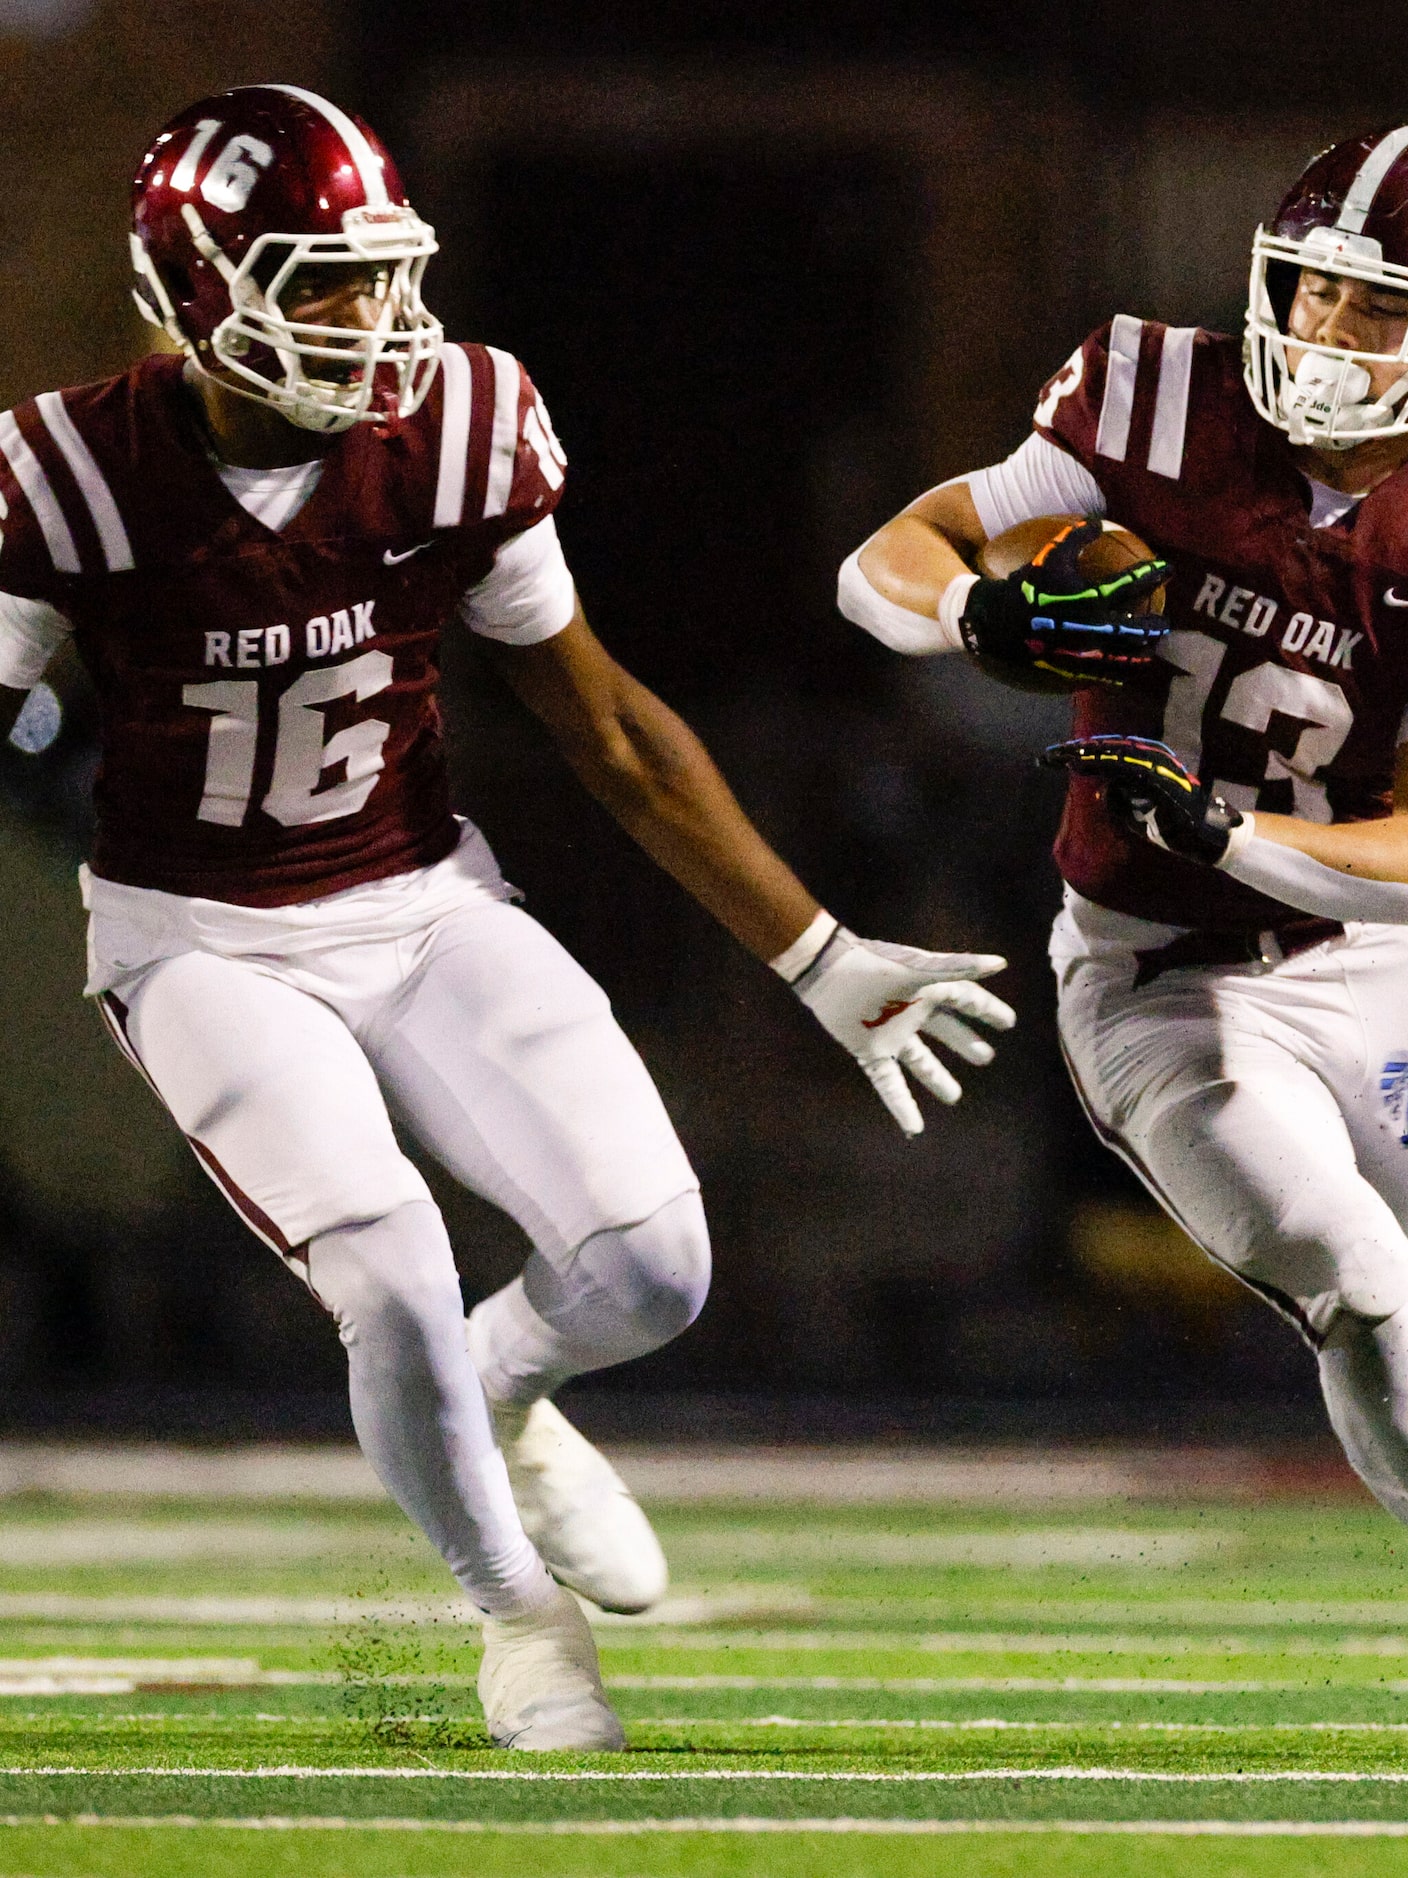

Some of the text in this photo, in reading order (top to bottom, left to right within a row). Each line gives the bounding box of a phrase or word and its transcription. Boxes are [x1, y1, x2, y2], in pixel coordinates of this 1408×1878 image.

[169, 119, 274, 213] 16
[204, 600, 376, 668] RED OAK
[1193, 573, 1364, 670] RED OAK
[182, 650, 394, 827] 16
[1155, 629, 1354, 825] 13
